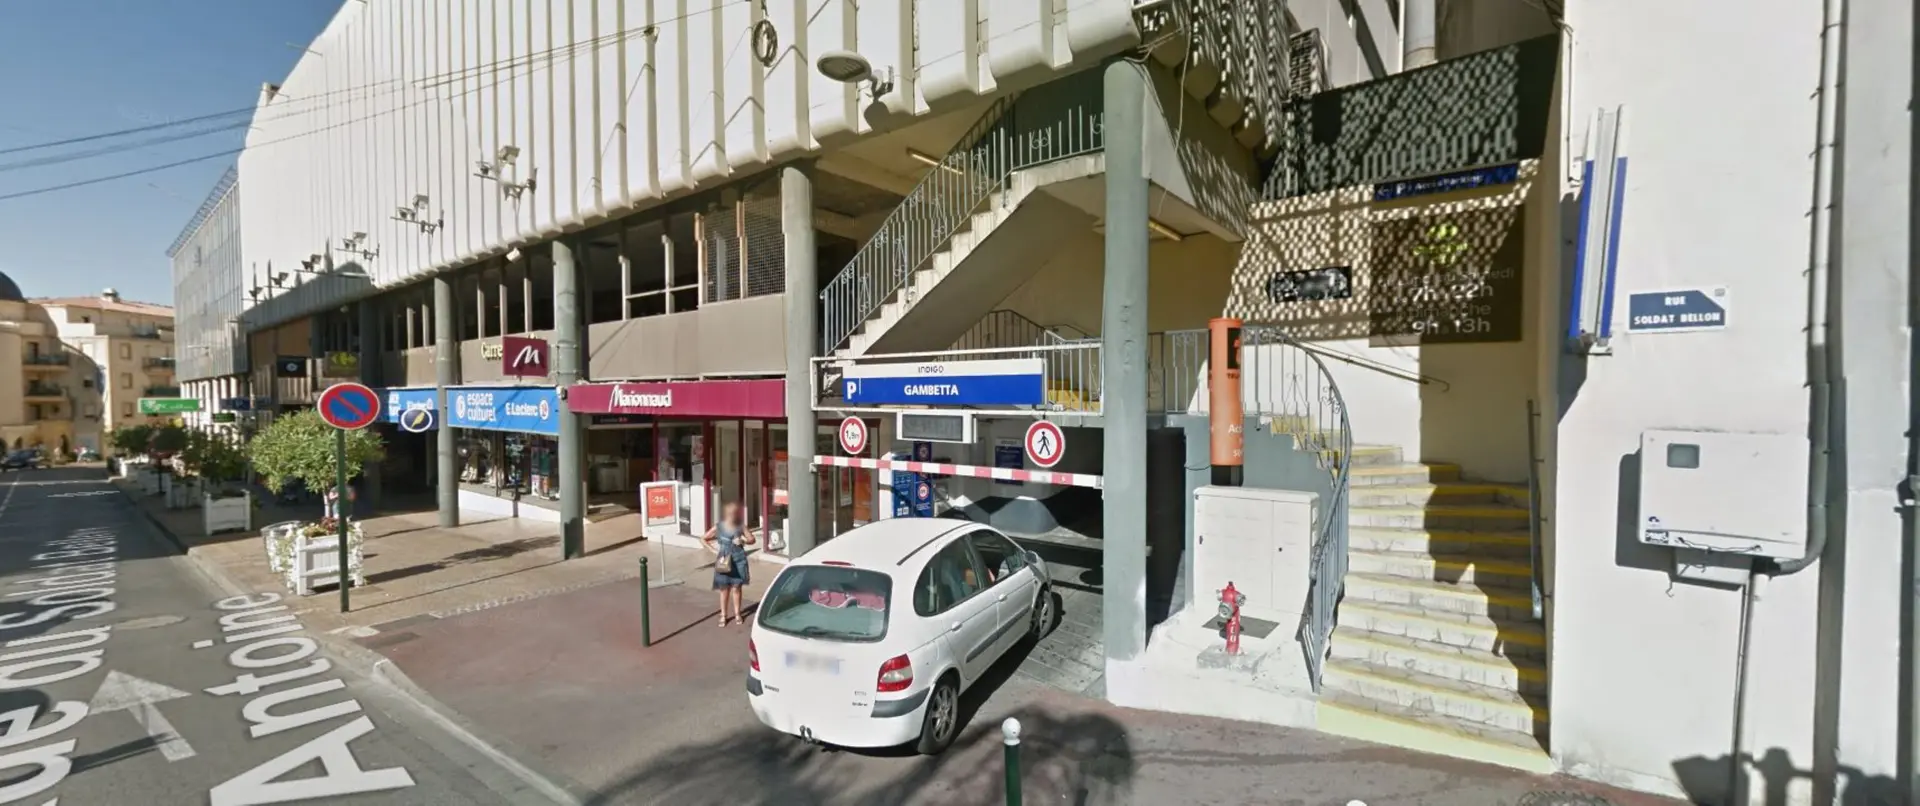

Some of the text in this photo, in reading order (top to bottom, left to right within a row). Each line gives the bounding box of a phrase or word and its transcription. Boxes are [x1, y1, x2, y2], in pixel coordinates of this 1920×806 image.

[1665, 296, 1686, 306] RUE
[1634, 312, 1720, 325] SOLDAT BELLON
[481, 342, 503, 359] Carre
[846, 381, 959, 399] P GAMBETTA
[467, 393, 493, 406] espace
[608, 384, 672, 412] Marionnaud
